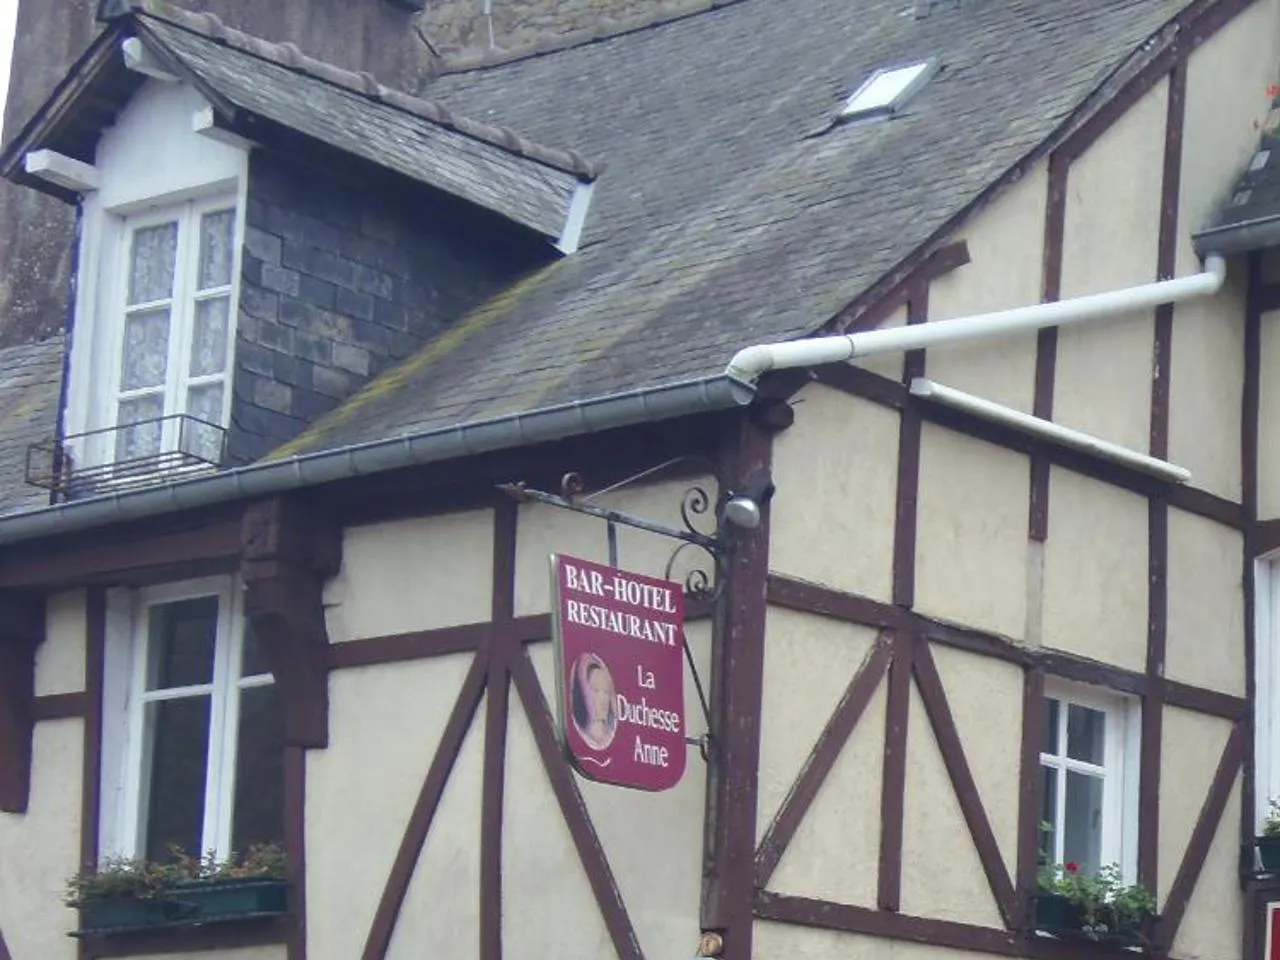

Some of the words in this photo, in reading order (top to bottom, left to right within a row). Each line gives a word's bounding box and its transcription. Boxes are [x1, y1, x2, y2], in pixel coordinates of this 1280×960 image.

[564, 564, 677, 614] BAR-HOTEL
[567, 600, 677, 647] RESTAURANT
[637, 664, 656, 690] La
[616, 694, 680, 734] Duchesse
[633, 736, 669, 768] Anne
